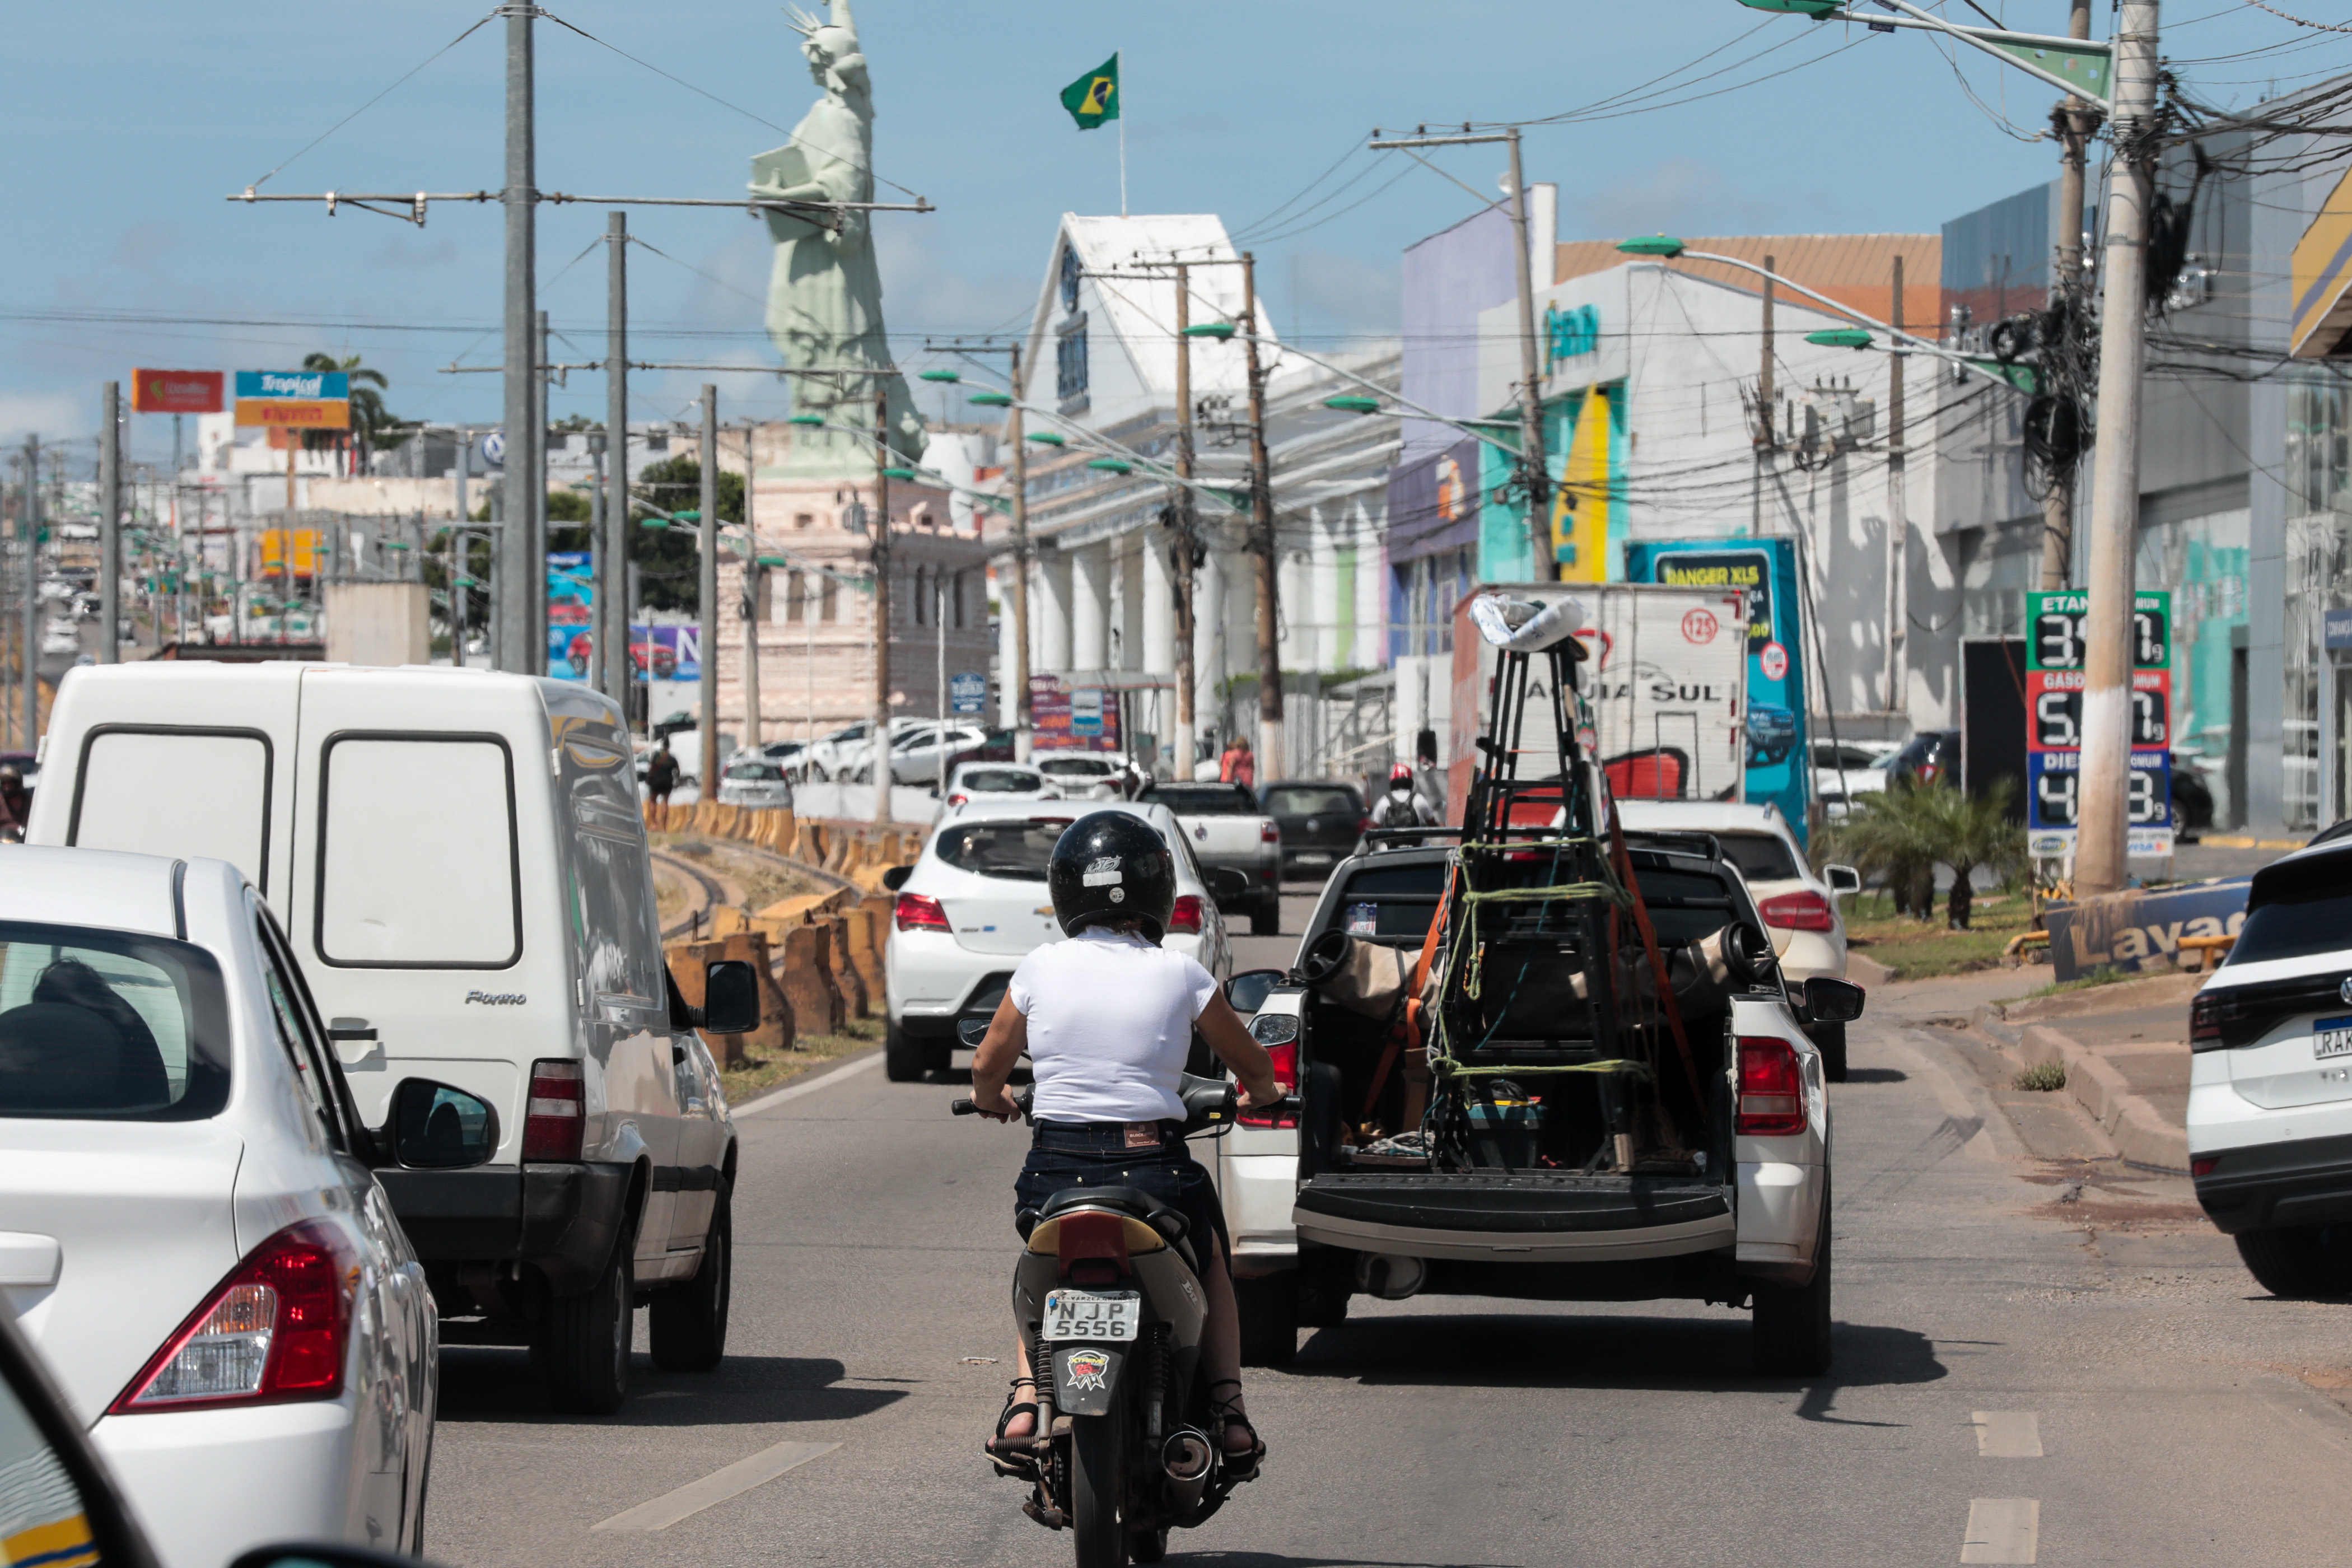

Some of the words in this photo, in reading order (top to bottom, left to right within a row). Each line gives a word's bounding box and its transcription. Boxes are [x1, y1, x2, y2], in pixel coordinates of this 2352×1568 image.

[260, 374, 323, 393] Tropical
[1664, 566, 1729, 585] RANGER
[1730, 565, 1760, 585] XLS
[2042, 595, 2089, 611] ETAN
[2135, 597, 2160, 610] MUM
[1688, 617, 1714, 637] 125
[2043, 671, 2085, 689] GASO
[1651, 682, 1721, 702] SUL
[2043, 752, 2080, 769] DIE
[2130, 753, 2162, 768] OMUM
[465, 990, 528, 1006] Fiorino
[1055, 1320, 1126, 1337] 5556
